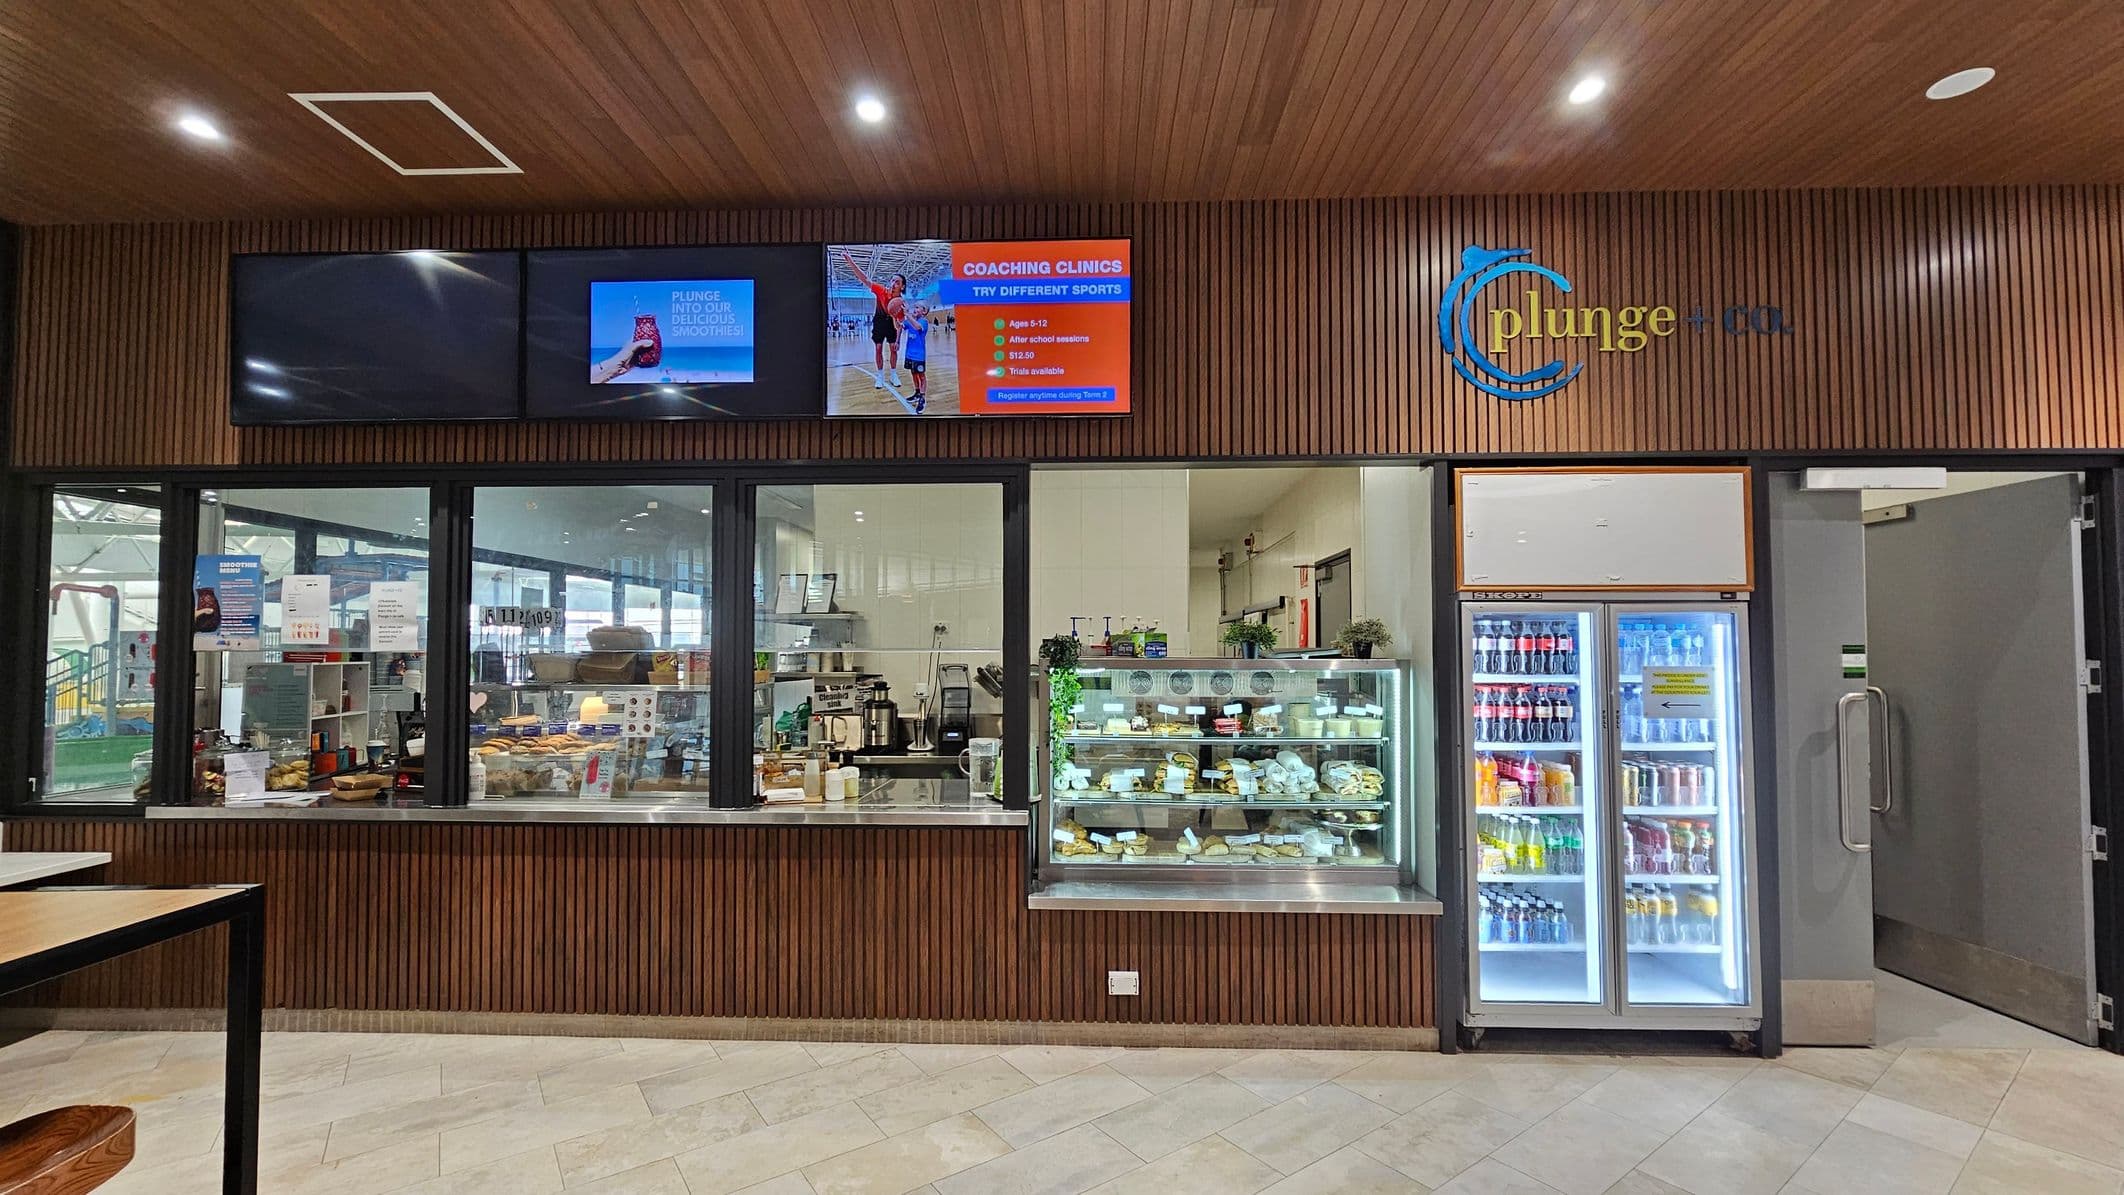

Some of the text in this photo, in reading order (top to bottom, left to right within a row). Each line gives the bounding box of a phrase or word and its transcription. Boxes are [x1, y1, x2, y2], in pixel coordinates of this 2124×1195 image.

[963, 260, 1123, 275] COACHING CLINICS
[972, 284, 1122, 297] TRY DIFFERENT SPORTS
[672, 291, 721, 301] PLUNGE
[672, 302, 732, 313] INTO OUR
[672, 313, 736, 324] DELICIOUS
[1489, 290, 1676, 353] plunge
[1724, 305, 1795, 335] co.
[1009, 319, 1048, 329] Ages 5-12
[672, 325, 744, 336] SMOOTHIES!
[1009, 335, 1090, 344] After school sessions
[1009, 351, 1035, 360] $12.50
[1009, 367, 1065, 376] Trials available
[998, 392, 1028, 401] Register
[1029, 392, 1057, 401] anytime
[1058, 391, 1082, 400] during
